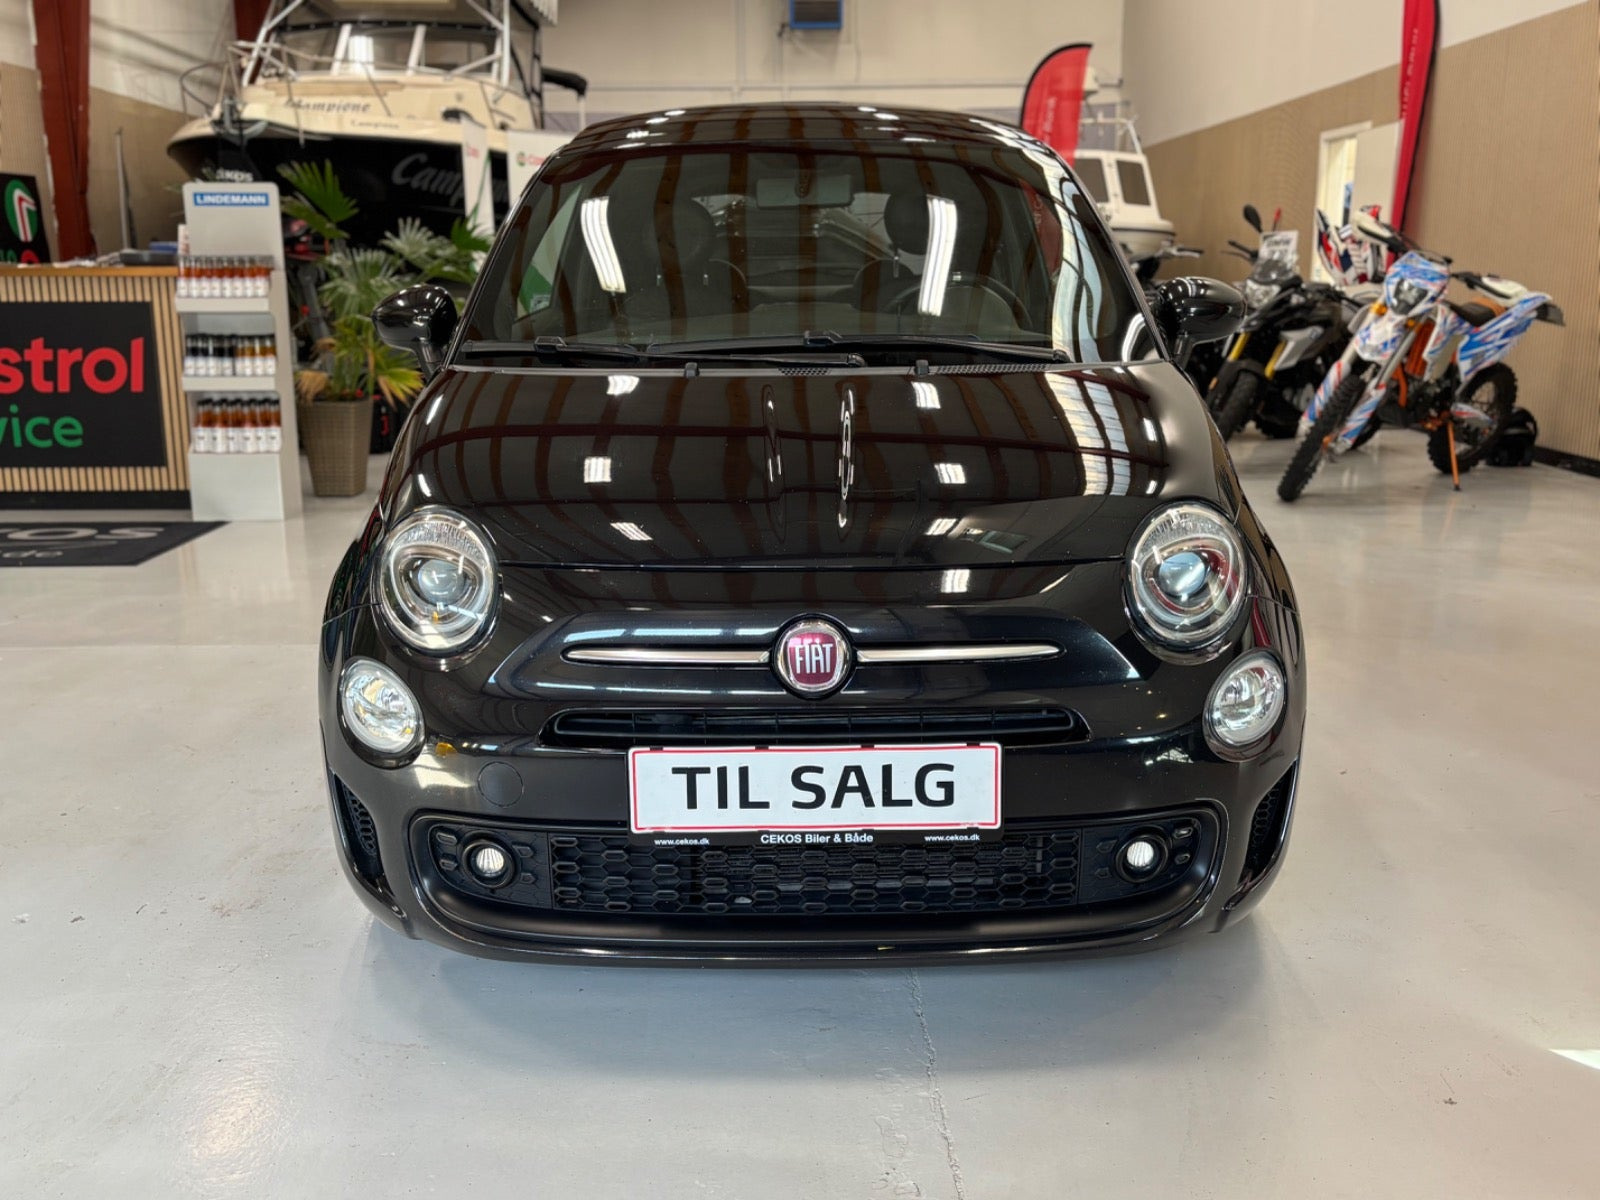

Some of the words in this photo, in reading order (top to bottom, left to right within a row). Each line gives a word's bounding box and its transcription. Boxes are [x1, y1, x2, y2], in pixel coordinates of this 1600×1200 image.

[195, 194, 267, 204] LINDEMANN
[0, 337, 145, 394] strol
[0, 527, 165, 541] OS
[795, 643, 834, 675] FIAT
[671, 765, 770, 809] TIL
[791, 763, 955, 809] SALG
[654, 837, 710, 846] www.cekos.dk
[760, 833, 802, 844] CEKOS
[805, 833, 831, 844] Biler
[833, 833, 843, 844] &
[845, 832, 874, 843] Både
[924, 834, 981, 843] www.cekos.dk
